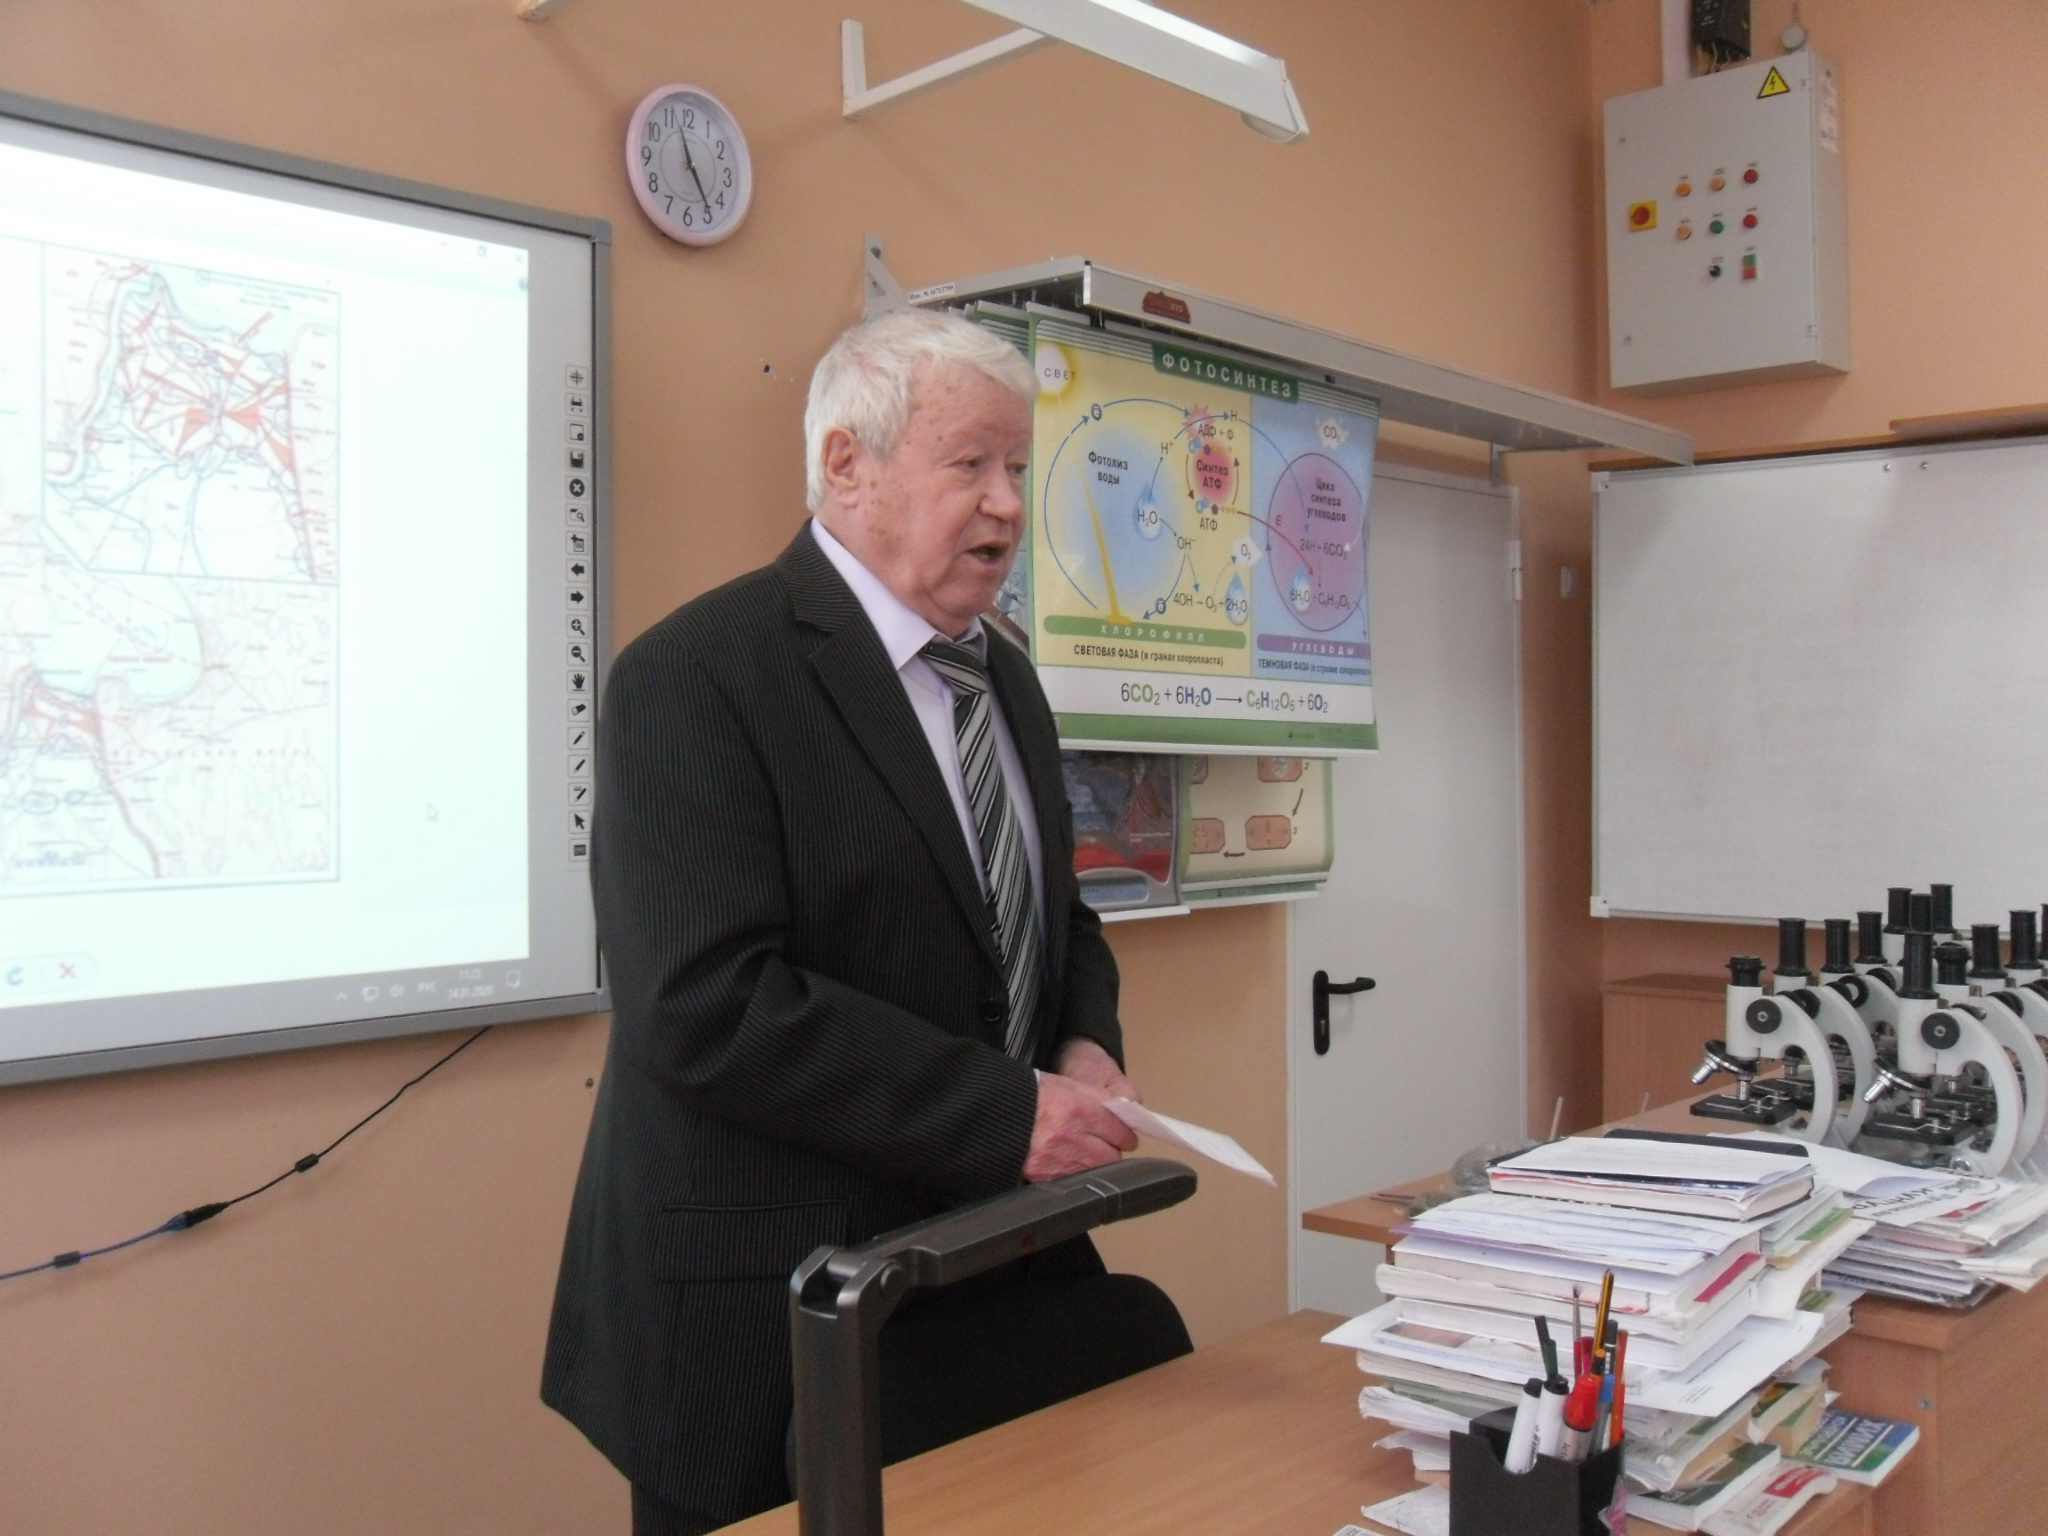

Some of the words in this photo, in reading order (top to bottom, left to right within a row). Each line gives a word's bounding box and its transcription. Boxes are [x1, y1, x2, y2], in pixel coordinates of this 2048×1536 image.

[664, 108, 674, 128] 11
[682, 109, 695, 129] 12
[648, 122, 661, 142] 10
[706, 120, 710, 138] 1
[641, 146, 651, 166] 9
[716, 140, 725, 160] 2
[648, 172, 658, 193] 8
[723, 168, 732, 187] 3
[665, 195, 673, 214] 7
[715, 192, 725, 209] 4
[683, 206, 692, 226] 6
[703, 205, 713, 224] 5
[1044, 367, 1076, 382] СВЕТ
[1162, 353, 1292, 397] ФОТОСИНТЕЗ
[1088, 451, 1129, 471] Фотолиз
[1197, 458, 1229, 476] Синтез
[1098, 471, 1120, 486] воды
[1203, 476, 1223, 490] АТФ
[1316, 478, 1335, 491] Цикл
[1311, 493, 1341, 507] синтеза
[1307, 506, 1346, 521] углеводов
[1200, 517, 1218, 532] АТФ
[1101, 624, 1204, 643] ХЛОРОФИЛЛ
[1074, 644, 1116, 657] СВЕТОВАЯ
[1118, 647, 1139, 659] ФАЗА
[1150, 652, 1175, 665] гранах
[1292, 642, 1354, 655] УГЛЕВОДЫ
[1258, 658, 1292, 670] ТЕМНОВАЯ
[1293, 662, 1309, 672] ФАЗА
[1121, 683, 1160, 706] 6CO2
[1176, 686, 1211, 707] 6H2O
